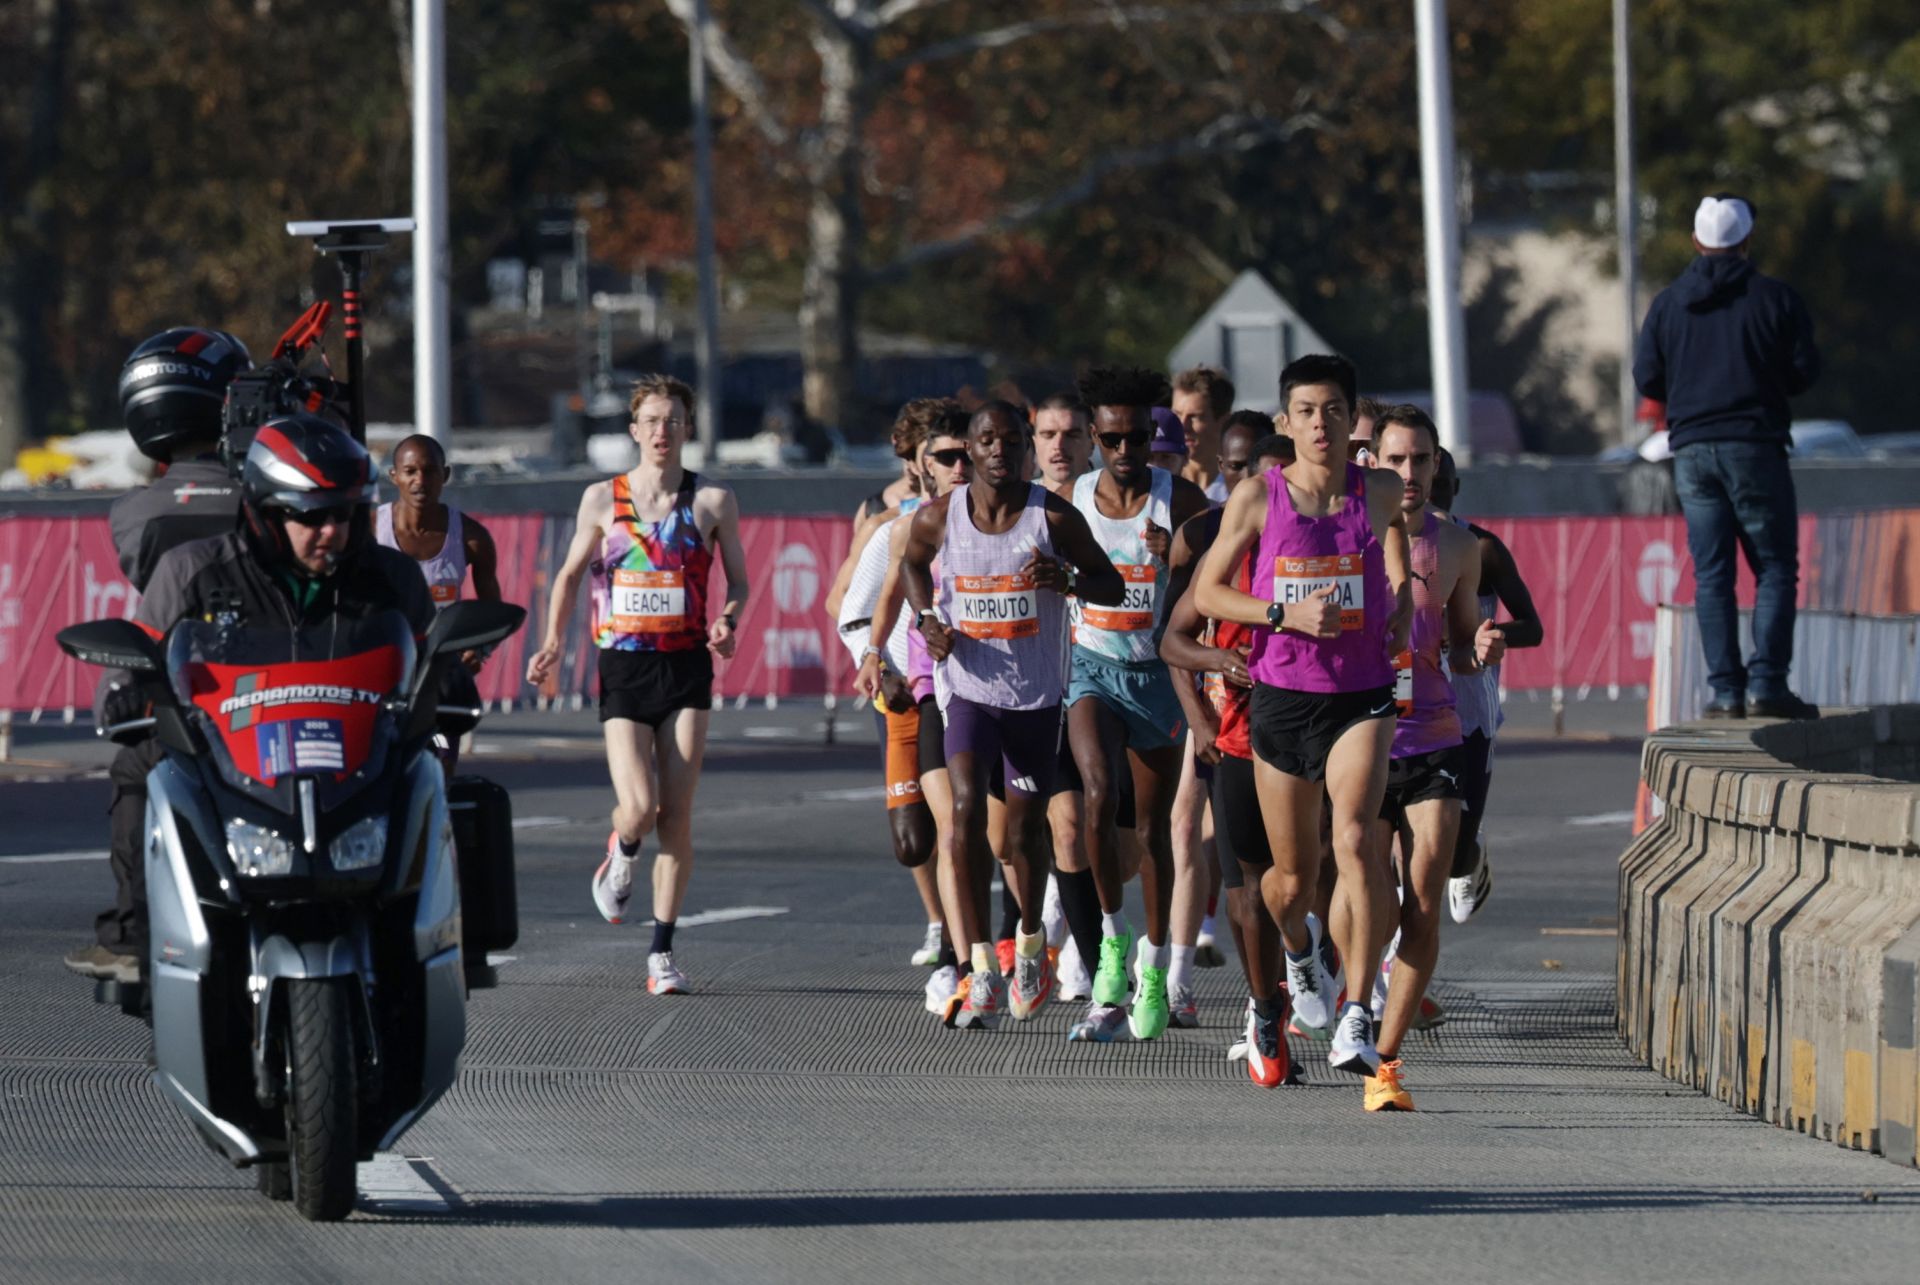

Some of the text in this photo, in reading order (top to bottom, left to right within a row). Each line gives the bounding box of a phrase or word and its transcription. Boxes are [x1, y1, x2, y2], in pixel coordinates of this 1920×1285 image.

[625, 593, 670, 613] LEACH
[964, 595, 1029, 619] KIPRUTO
[220, 685, 381, 715] MEDIAMOTOS.TV
